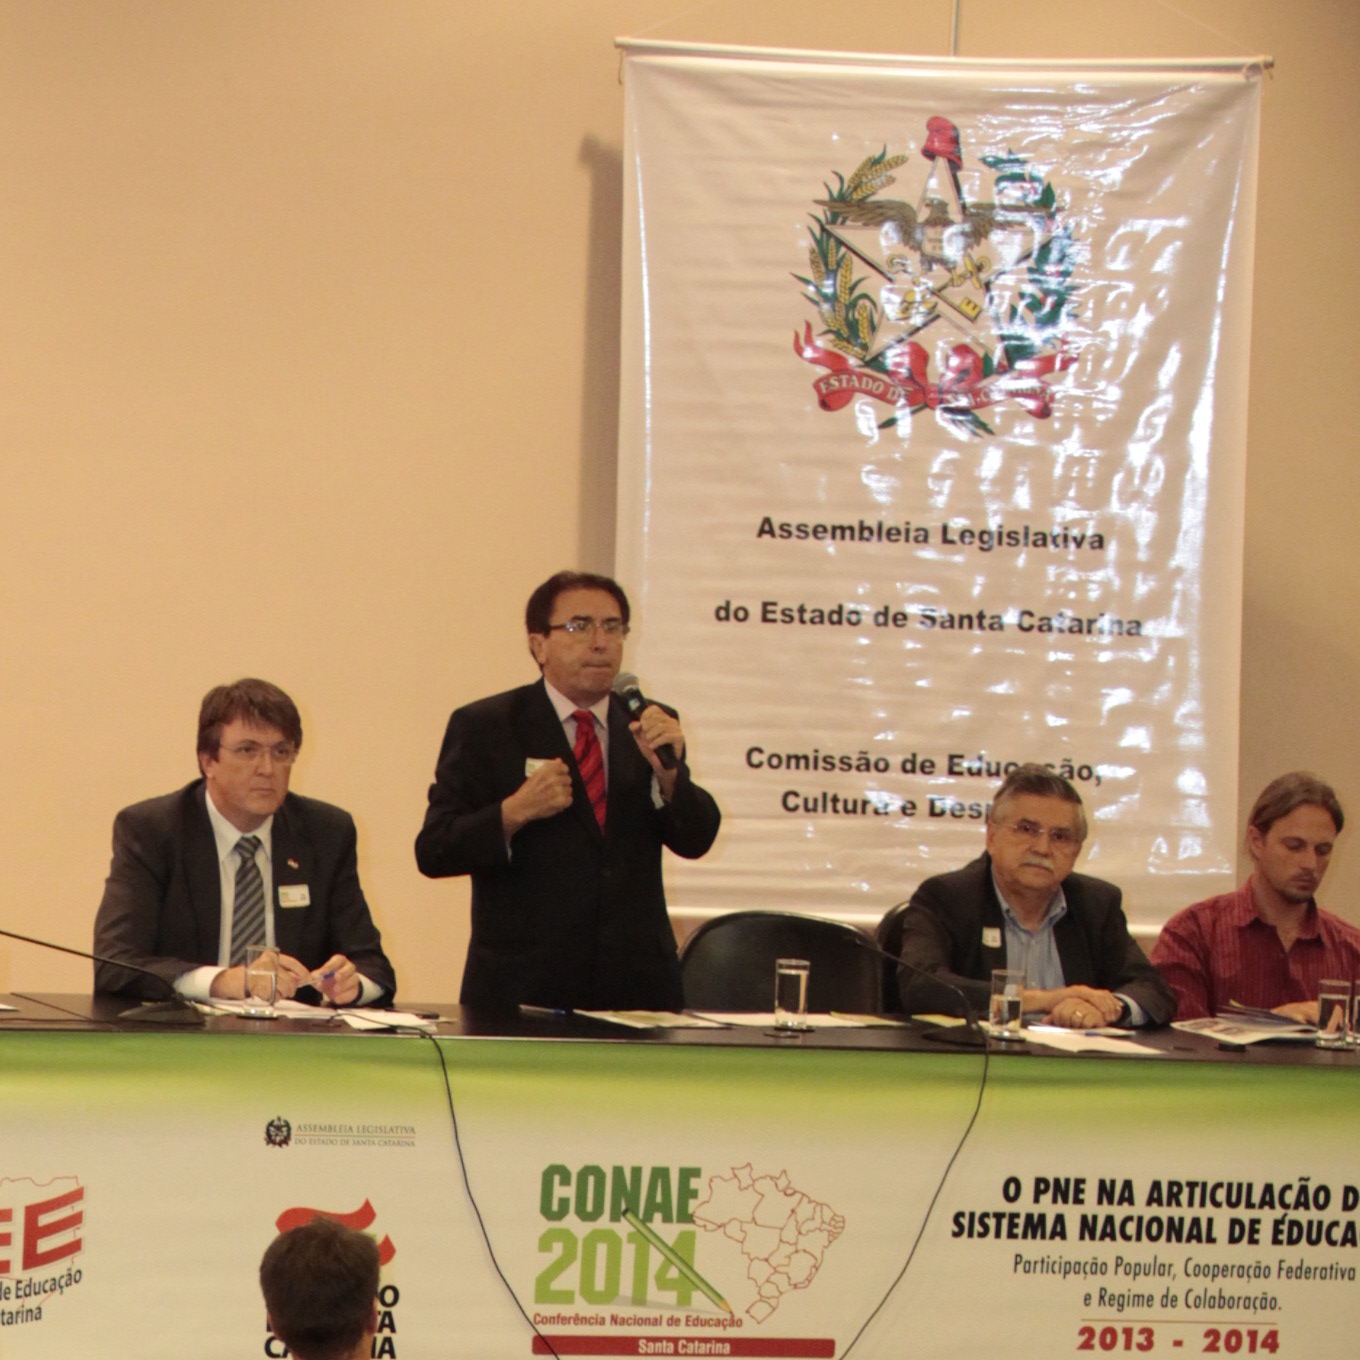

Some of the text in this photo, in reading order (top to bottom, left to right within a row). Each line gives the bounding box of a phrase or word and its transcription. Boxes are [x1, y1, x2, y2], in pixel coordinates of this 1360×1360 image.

[756, 516, 1105, 551] Assembleia Legislativa
[714, 600, 1143, 637] do Estado de Santa Catarina
[745, 746, 1103, 787] Comissão de Educão,
[781, 790, 890, 816] Cultura
[900, 798, 918, 818] e
[294, 1137, 307, 1146] DO
[308, 1138, 338, 1146] ESTADO
[352, 1138, 377, 1147] SANTA
[296, 1123, 416, 1135] ASSEMBLEIA LEGISLATIVA
[539, 1163, 702, 1224] CONAE
[1002, 1176, 1022, 1203] O
[1032, 1177, 1087, 1205] PNE
[1097, 1178, 1135, 1207] NA
[1145, 1176, 1331, 1214] ARTICULAÇÃO
[951, 1211, 1067, 1241] SISTEMA
[1079, 1214, 1217, 1245] NACIONAL
[1227, 1217, 1262, 1246] DE
[533, 1227, 701, 1307] 2014
[1013, 1253, 1357, 1284] Participação Popular, Cooperação Federativa
[15, 1267, 83, 1300] Educação
[1083, 1286, 1282, 1315] e Regime de Colaboração.
[533, 1312, 743, 1330] Conferência Nacional de Educação
[638, 1338, 731, 1355] Santa Catarina
[1076, 1326, 1155, 1352] 2013
[1201, 1328, 1280, 1354] 2014
